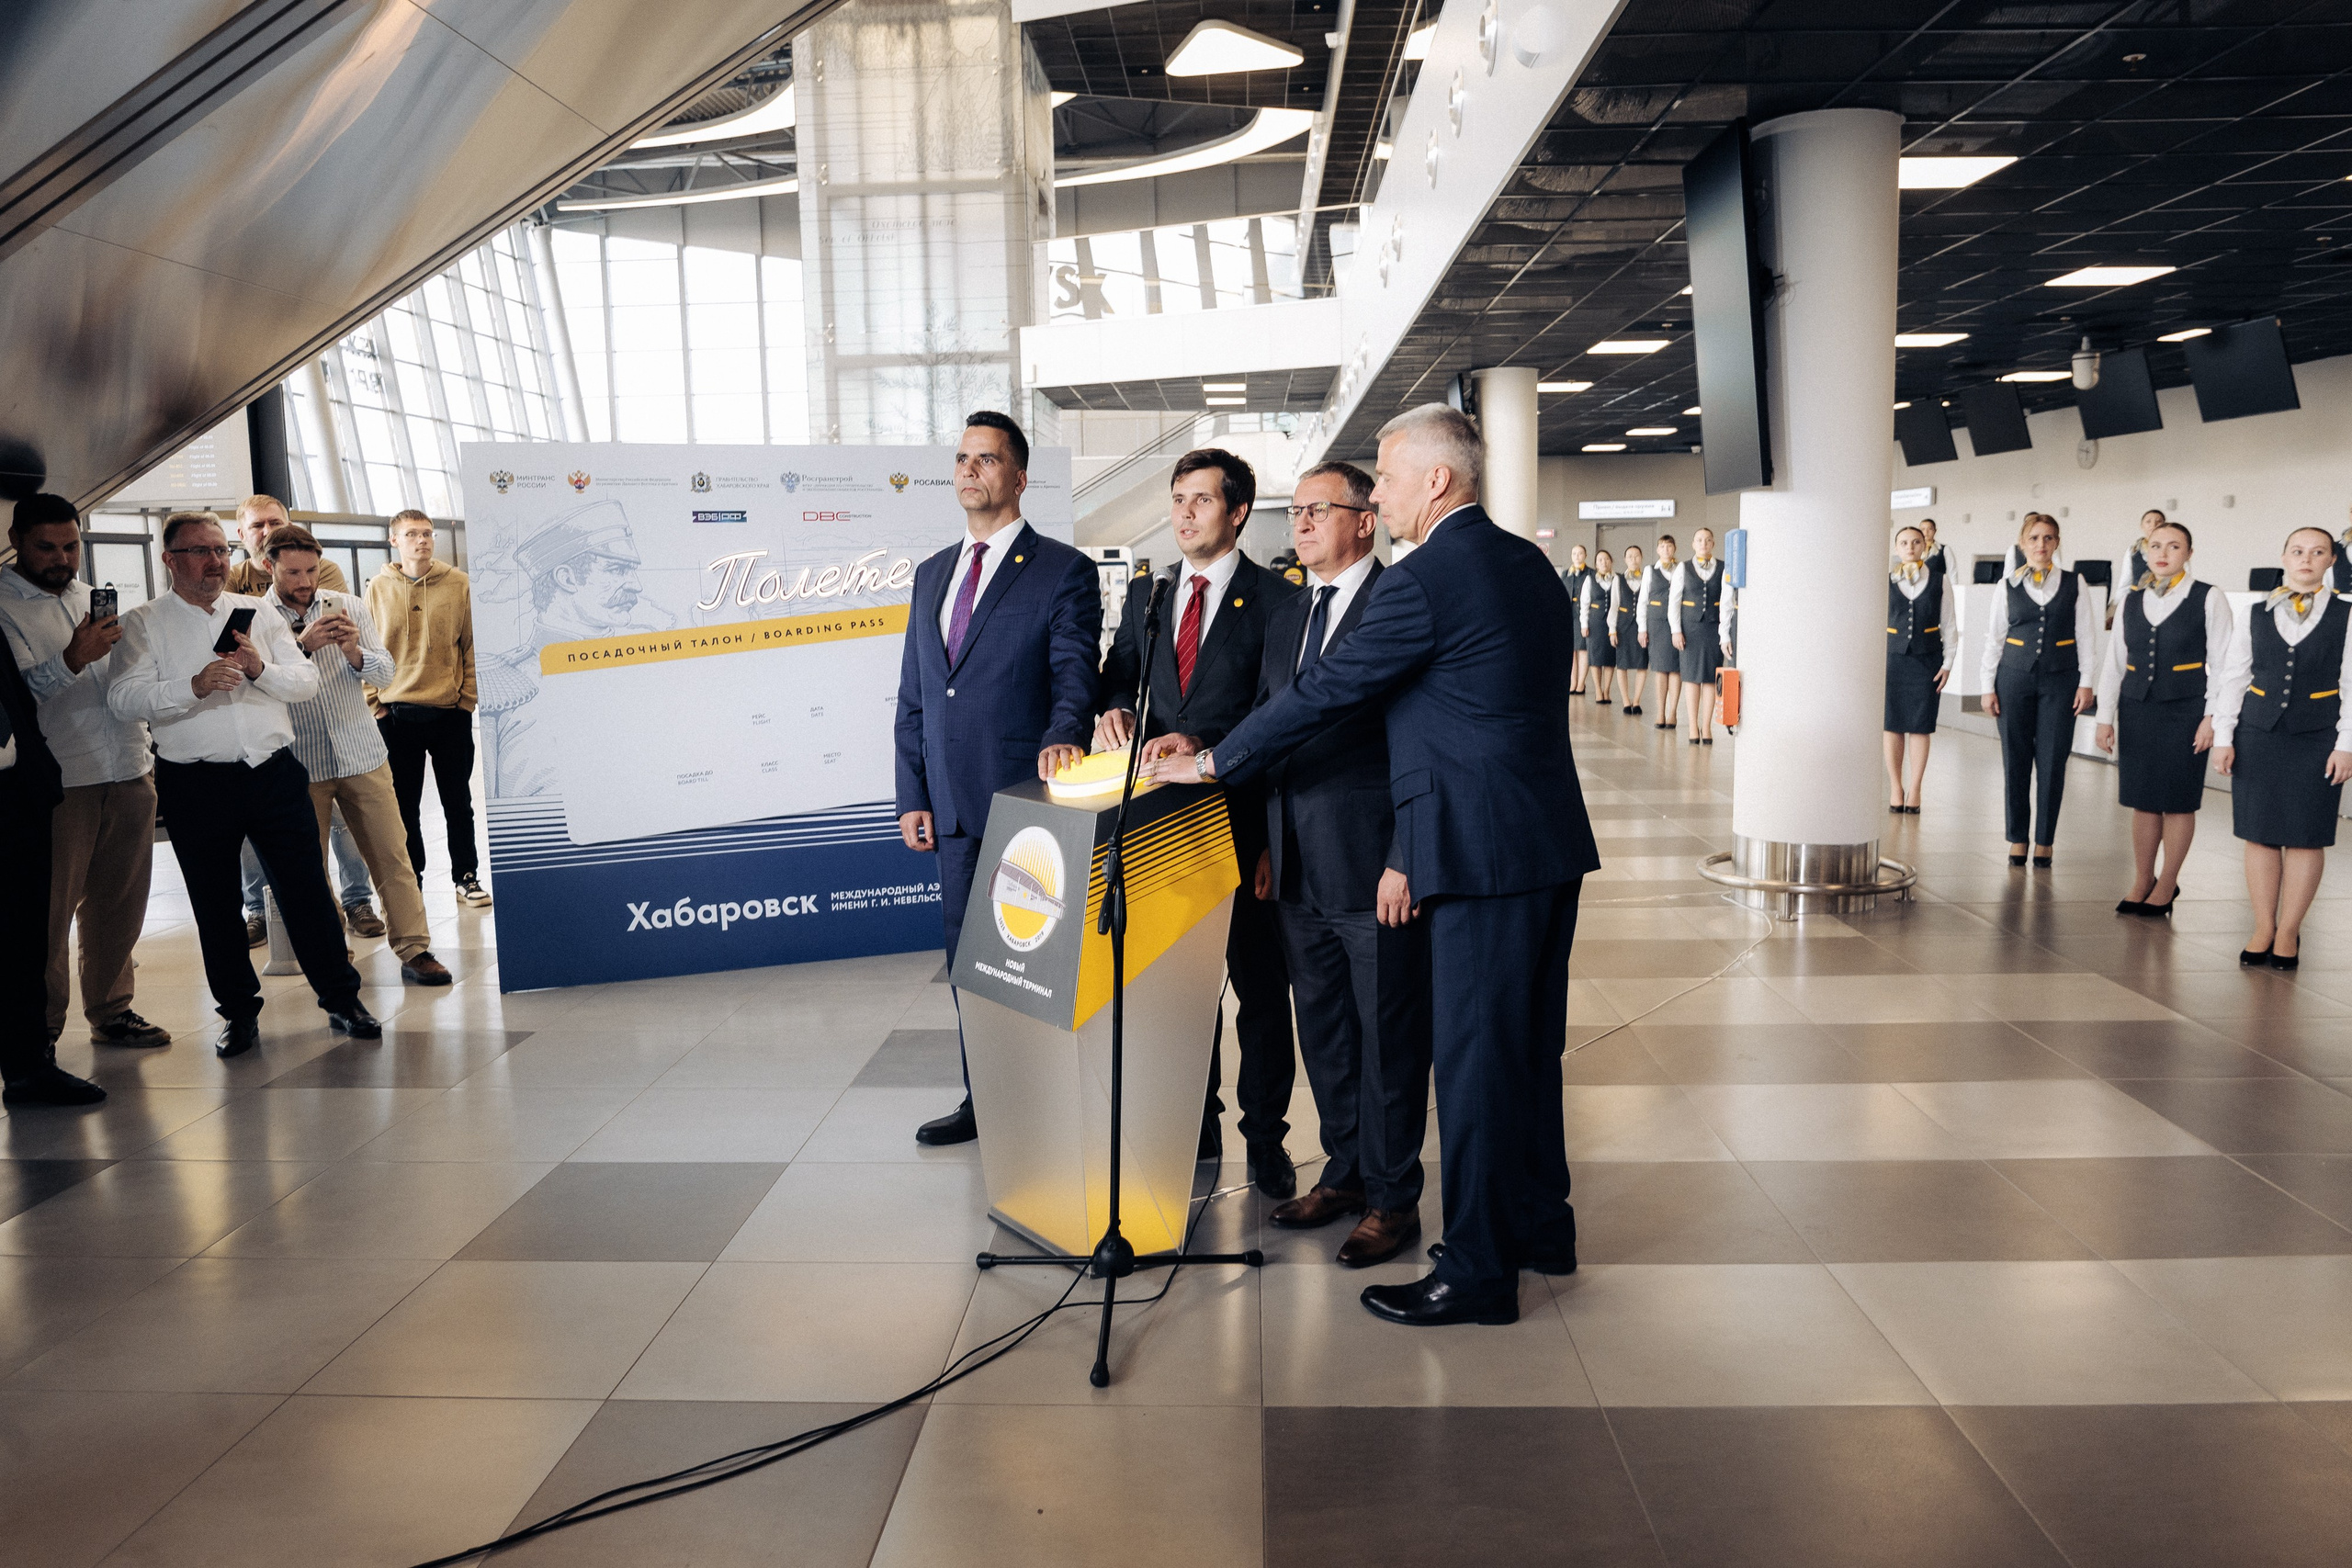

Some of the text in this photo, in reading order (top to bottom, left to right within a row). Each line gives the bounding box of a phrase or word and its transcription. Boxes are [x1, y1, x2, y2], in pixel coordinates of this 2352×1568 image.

[1050, 265, 1114, 314] SK
[802, 511, 851, 521] DBC
[697, 547, 915, 612] Полете
[568, 617, 885, 662] ПОСАДОЧНЫЙ ТАЛОН / BOARDING PASS
[676, 771, 704, 779] ПОСАДКА
[831, 883, 941, 900] МЕЖДУНАРОДНЫЙ АЭ
[831, 893, 943, 911] ИМЕНИ Г. И. НЕВЕЛЬСК
[627, 894, 820, 931] Хабаровск
[1006, 934, 1031, 948] ХАБАРОВСК
[1005, 958, 1026, 973] НОВЫЙ
[975, 961, 1053, 998] МЕЖДУНАРОДНЫЙ ТЕРМИНАЛ
